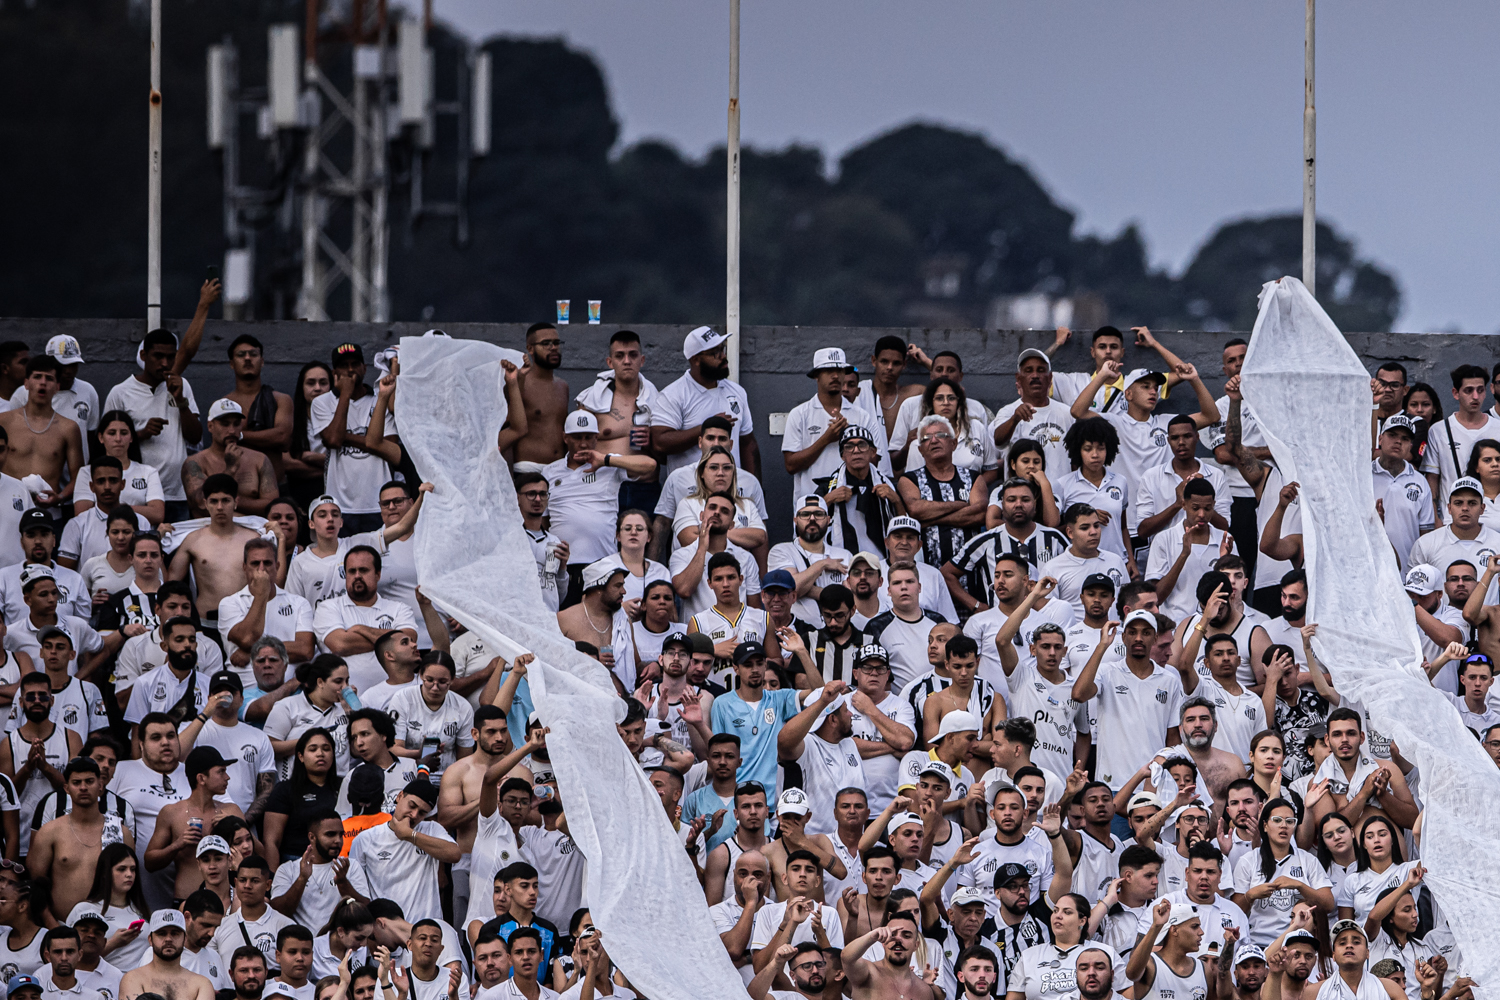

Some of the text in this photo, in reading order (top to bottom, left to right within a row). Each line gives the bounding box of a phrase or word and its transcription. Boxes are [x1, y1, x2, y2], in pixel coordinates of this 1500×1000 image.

[1028, 422, 1066, 437] TORCIDA JOVEM
[711, 630, 726, 639] 1912
[859, 644, 887, 657] 1912
[1041, 741, 1069, 755] BINAN
[1040, 968, 1076, 982] Charl
